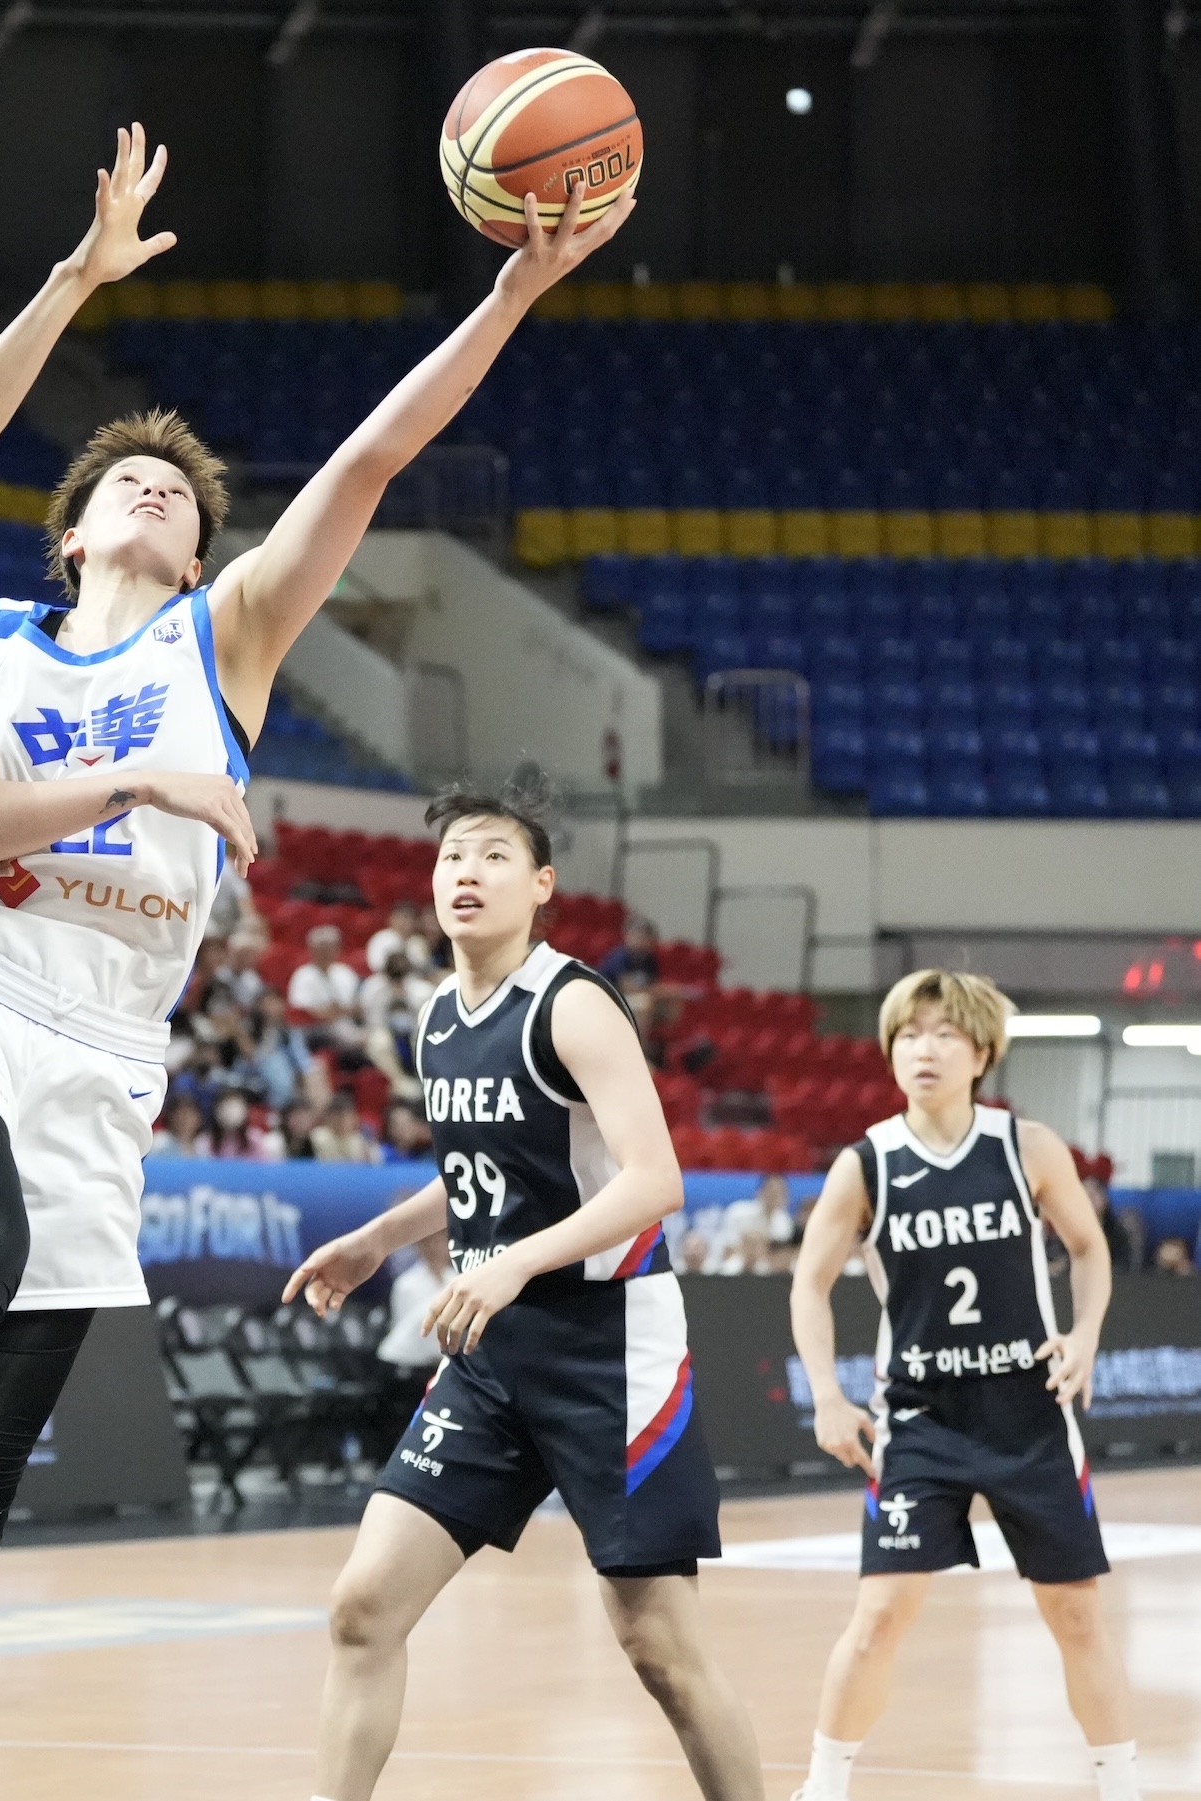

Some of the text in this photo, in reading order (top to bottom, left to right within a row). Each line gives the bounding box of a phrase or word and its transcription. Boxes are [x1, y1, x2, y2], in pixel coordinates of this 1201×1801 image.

[12, 682, 171, 767] 中華
[55, 875, 191, 923] YULON
[444, 1151, 506, 1220] 39
[888, 1199, 1022, 1252] KOREA
[944, 1266, 982, 1326] 2
[935, 1338, 1035, 1377] 하나은행
[399, 1448, 444, 1477] 하나은행
